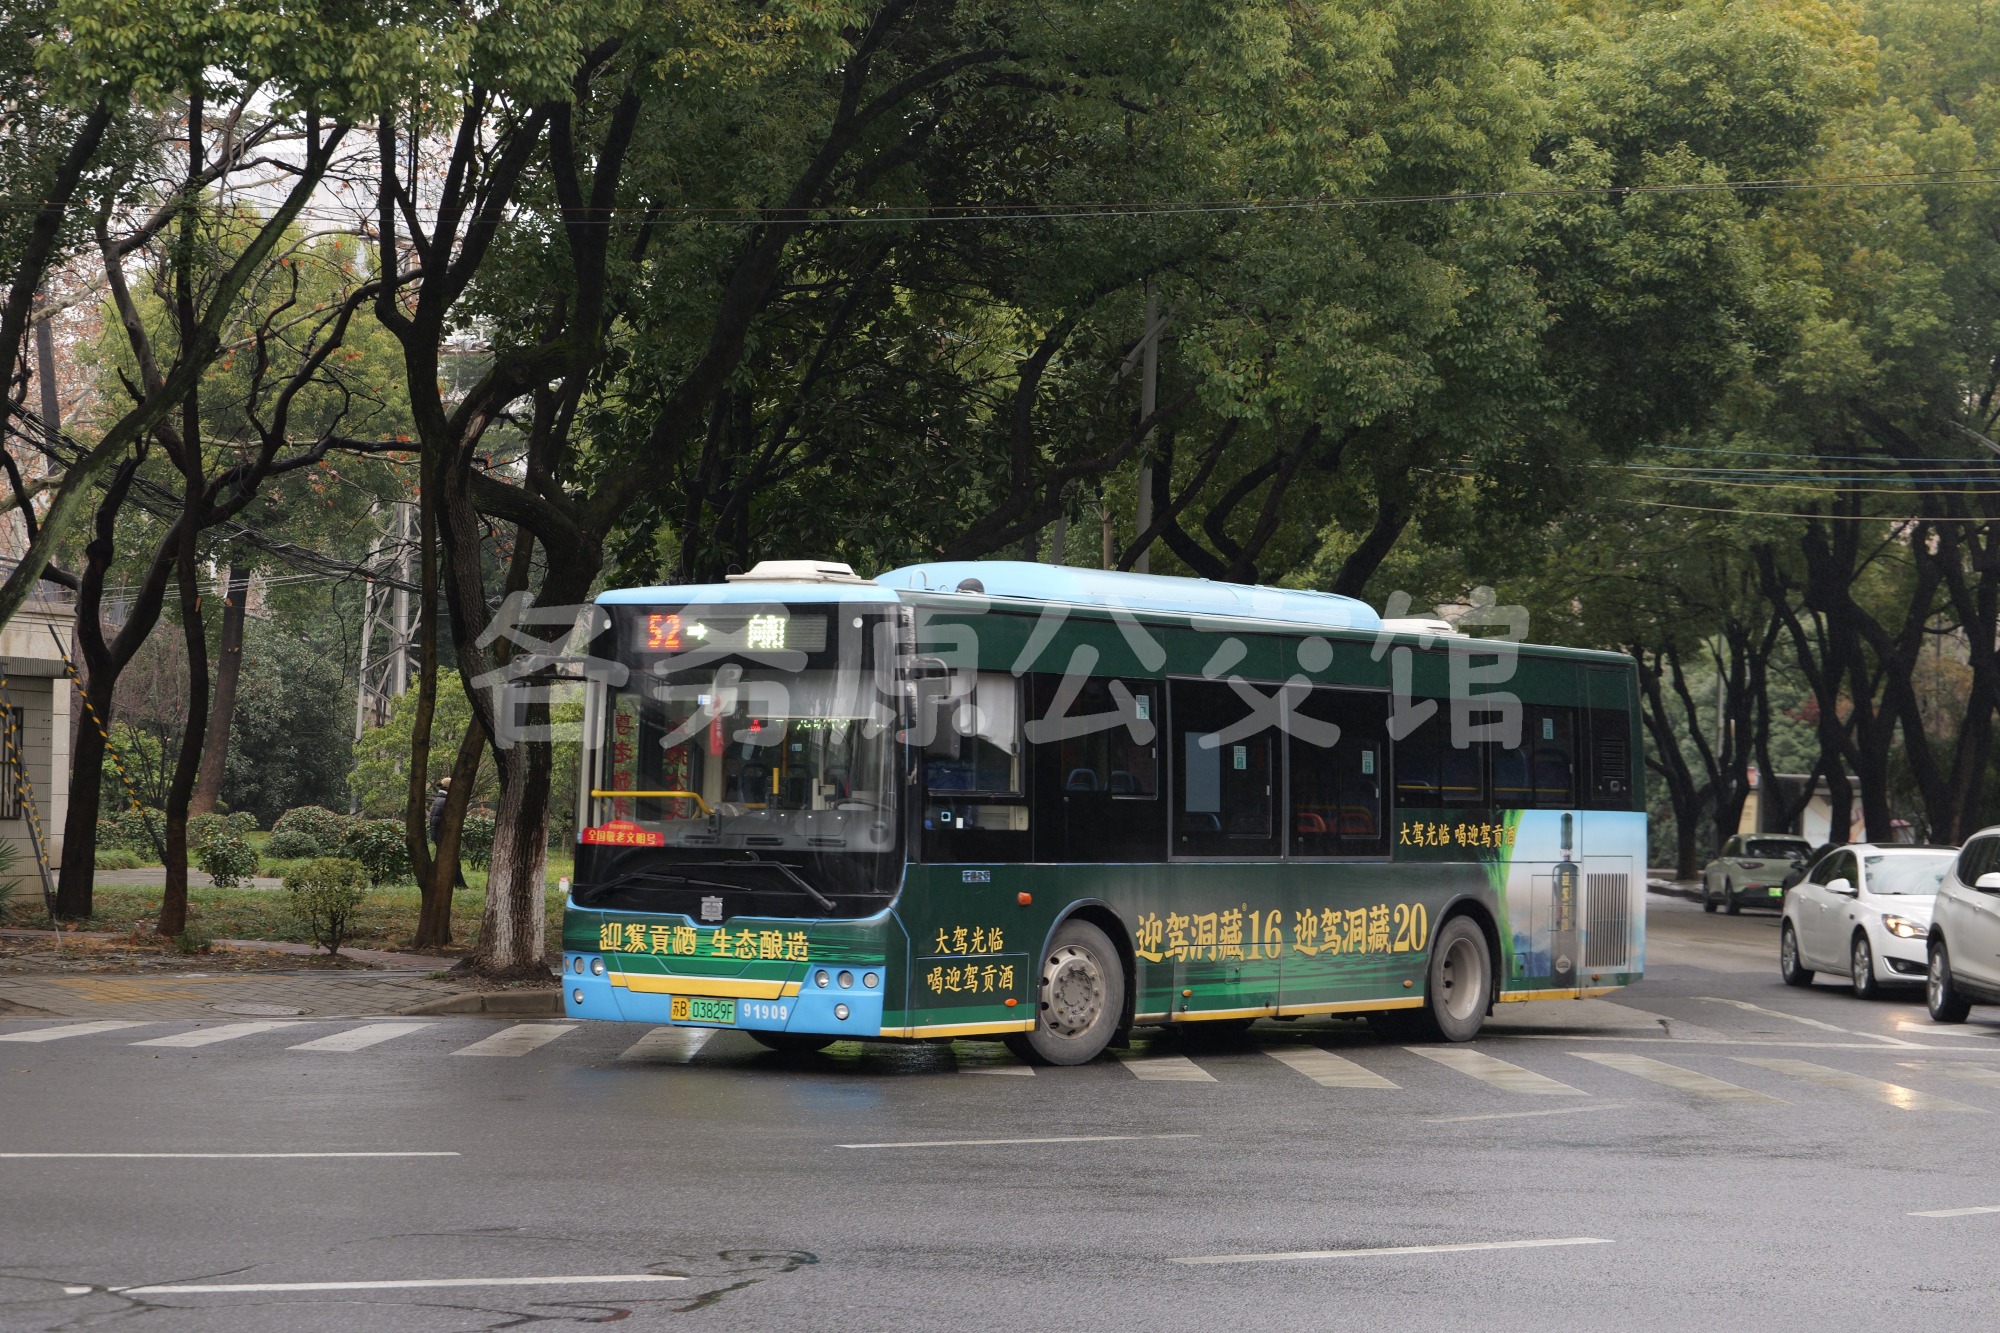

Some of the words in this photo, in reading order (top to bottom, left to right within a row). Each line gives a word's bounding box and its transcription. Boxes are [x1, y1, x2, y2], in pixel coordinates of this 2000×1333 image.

[648, 614, 680, 648] 52
[588, 829, 657, 845] 全国敬老文明号
[1399, 821, 1450, 848] 大驾光临
[1454, 822, 1516, 848] 喝迎驾贡酒
[711, 927, 809, 962] 生态酿造
[934, 925, 1004, 955] 大驾光临
[1292, 903, 1428, 955] 迎驾洞藏20
[926, 963, 1014, 995] 喝迎驾贡酒
[743, 1003, 788, 1021] 91909
